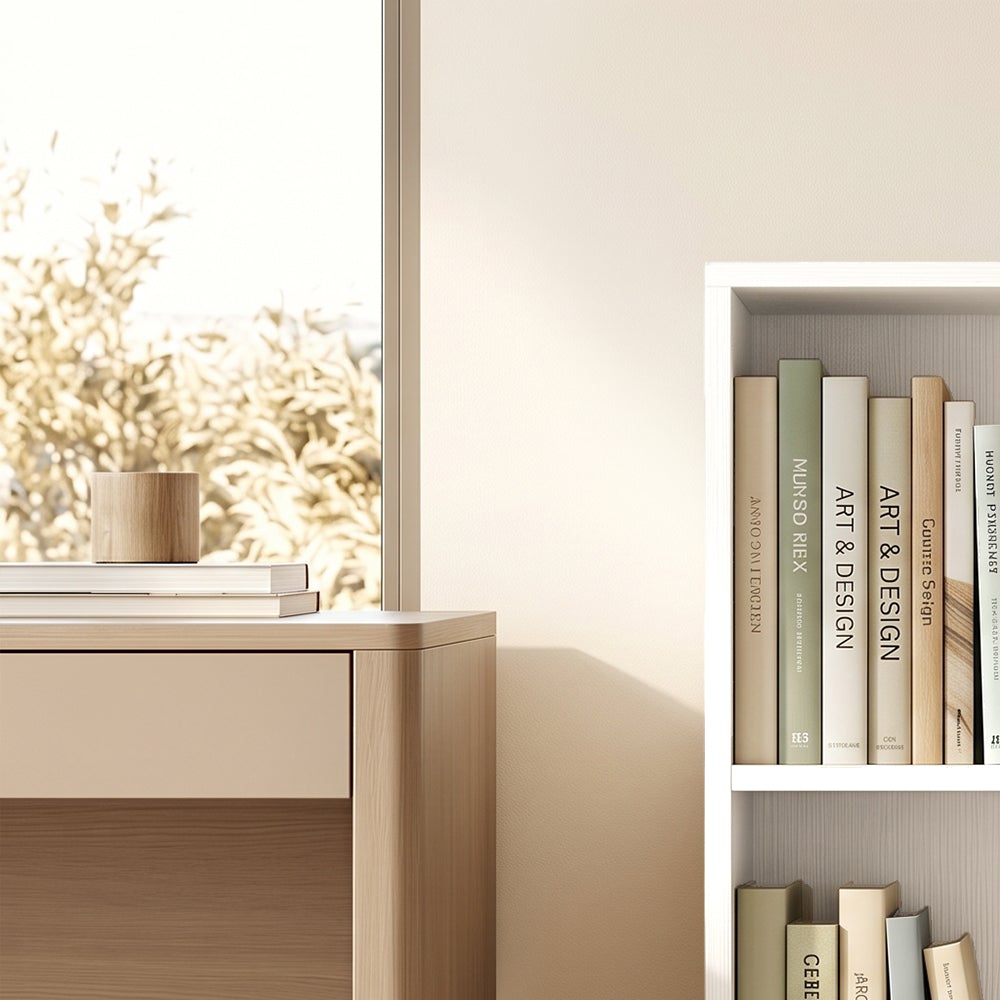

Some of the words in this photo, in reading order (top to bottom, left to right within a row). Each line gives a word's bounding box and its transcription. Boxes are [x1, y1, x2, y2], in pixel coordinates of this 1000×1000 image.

[835, 486, 854, 532] ART
[879, 485, 900, 536] ART
[792, 532, 808, 574] RIEX
[835, 540, 854, 556] &
[879, 542, 900, 559] &
[835, 564, 854, 649] DESIGN
[879, 568, 900, 662] DESIGN
